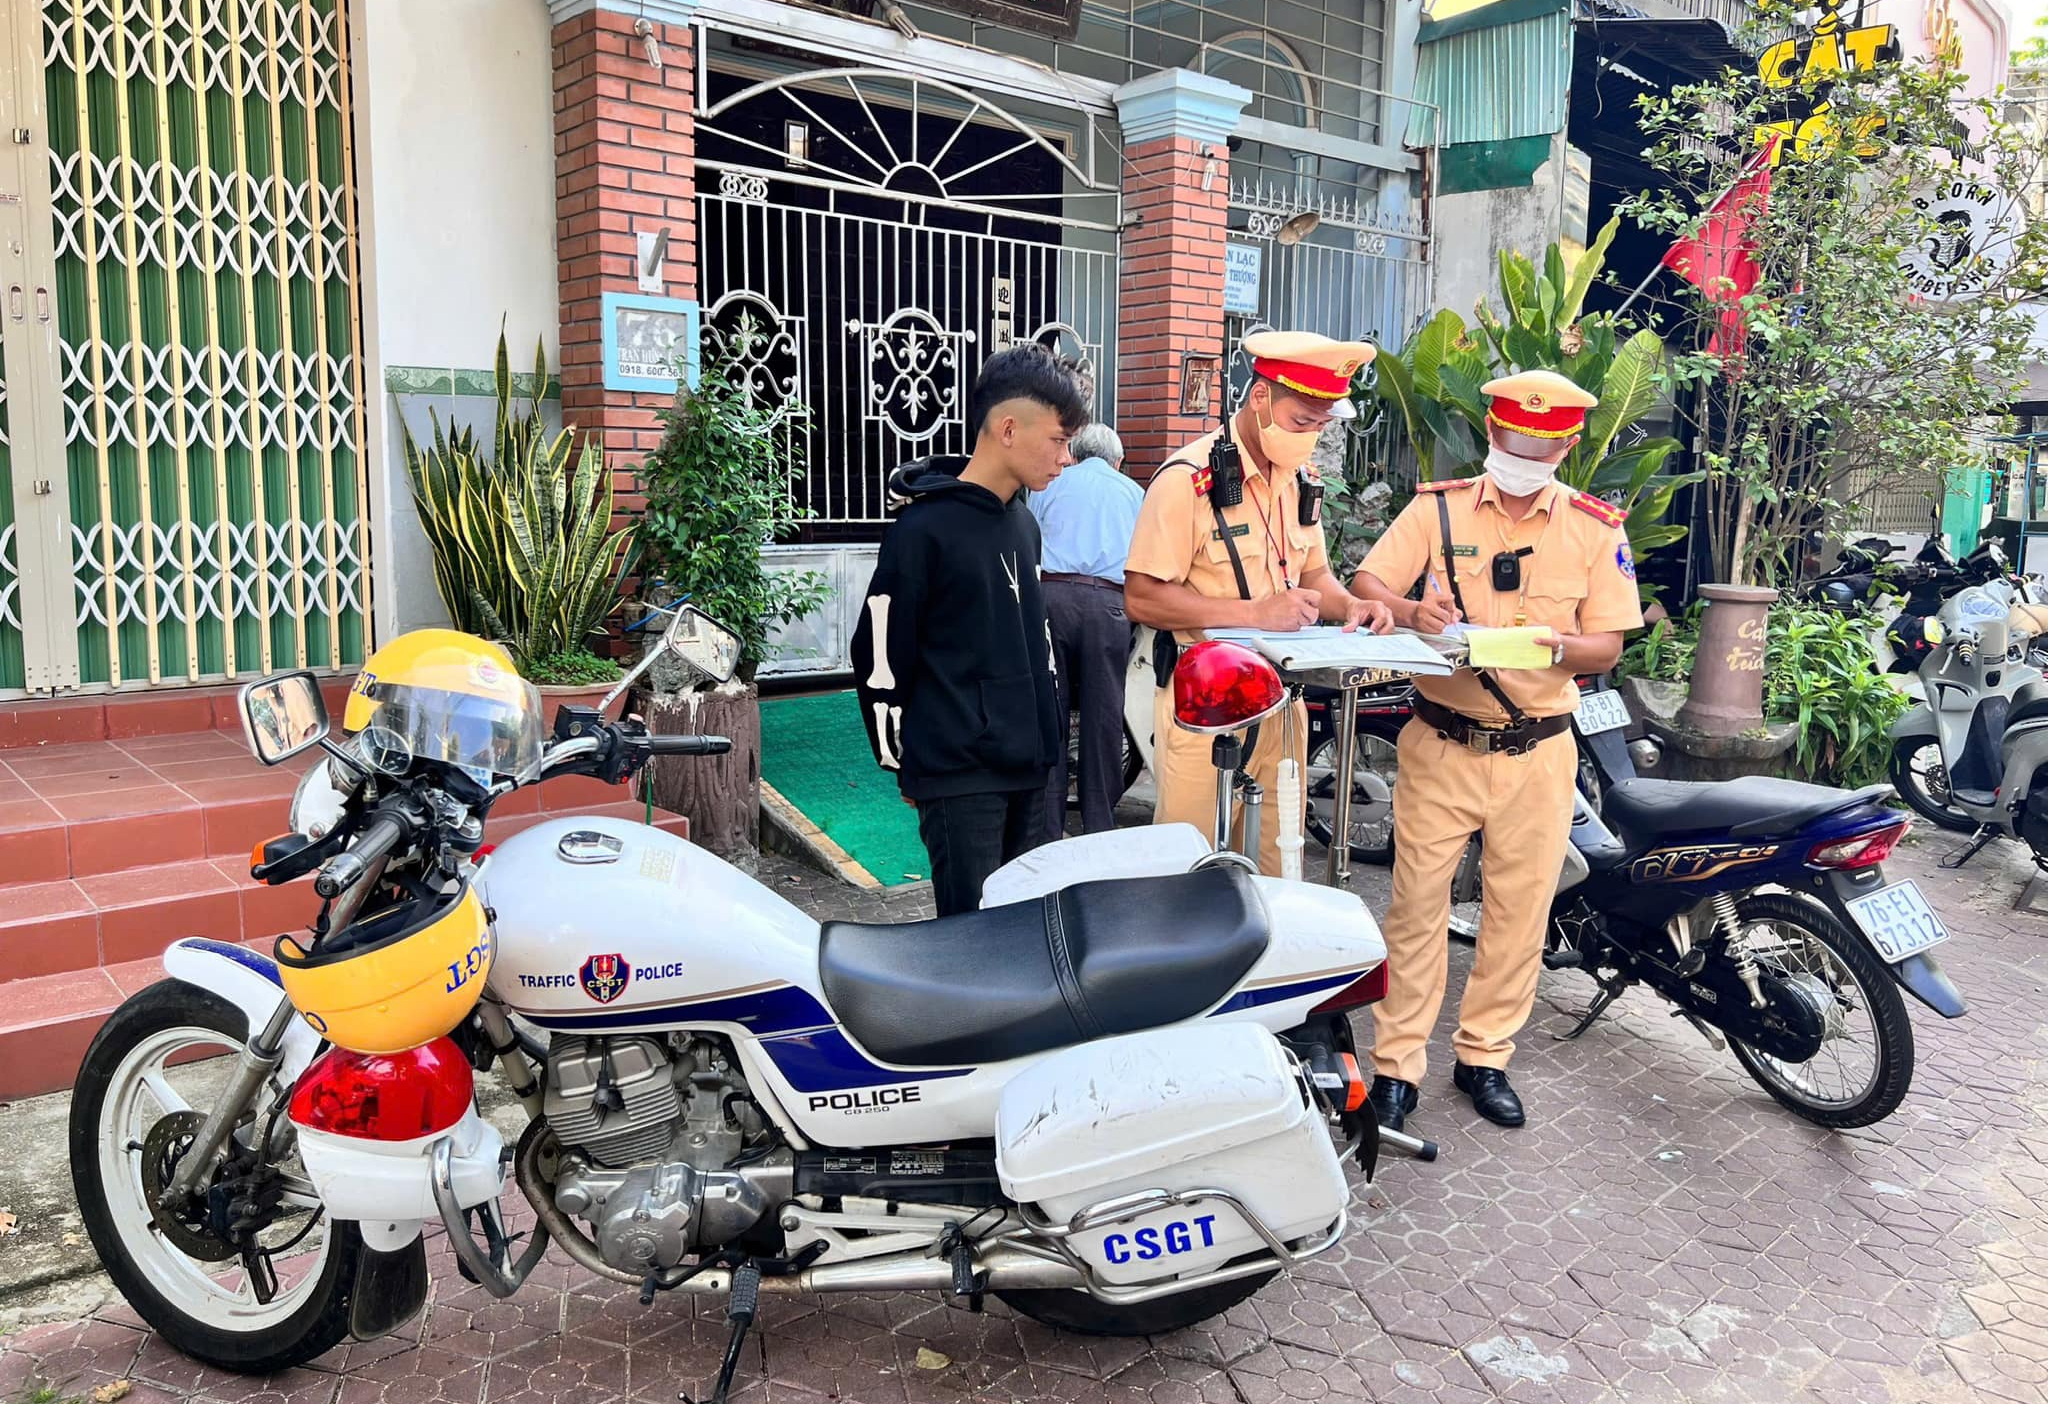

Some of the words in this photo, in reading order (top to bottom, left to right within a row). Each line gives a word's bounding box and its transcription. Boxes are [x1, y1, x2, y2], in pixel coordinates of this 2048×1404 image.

[1873, 912, 1944, 957] 673.12
[518, 974, 576, 988] TRAFFIC
[635, 962, 683, 982] POLICE
[586, 978, 624, 989] CSGT
[808, 1086, 921, 1112] POLICE
[864, 1105, 890, 1114] 250
[1103, 1214, 1215, 1264] CSGT
